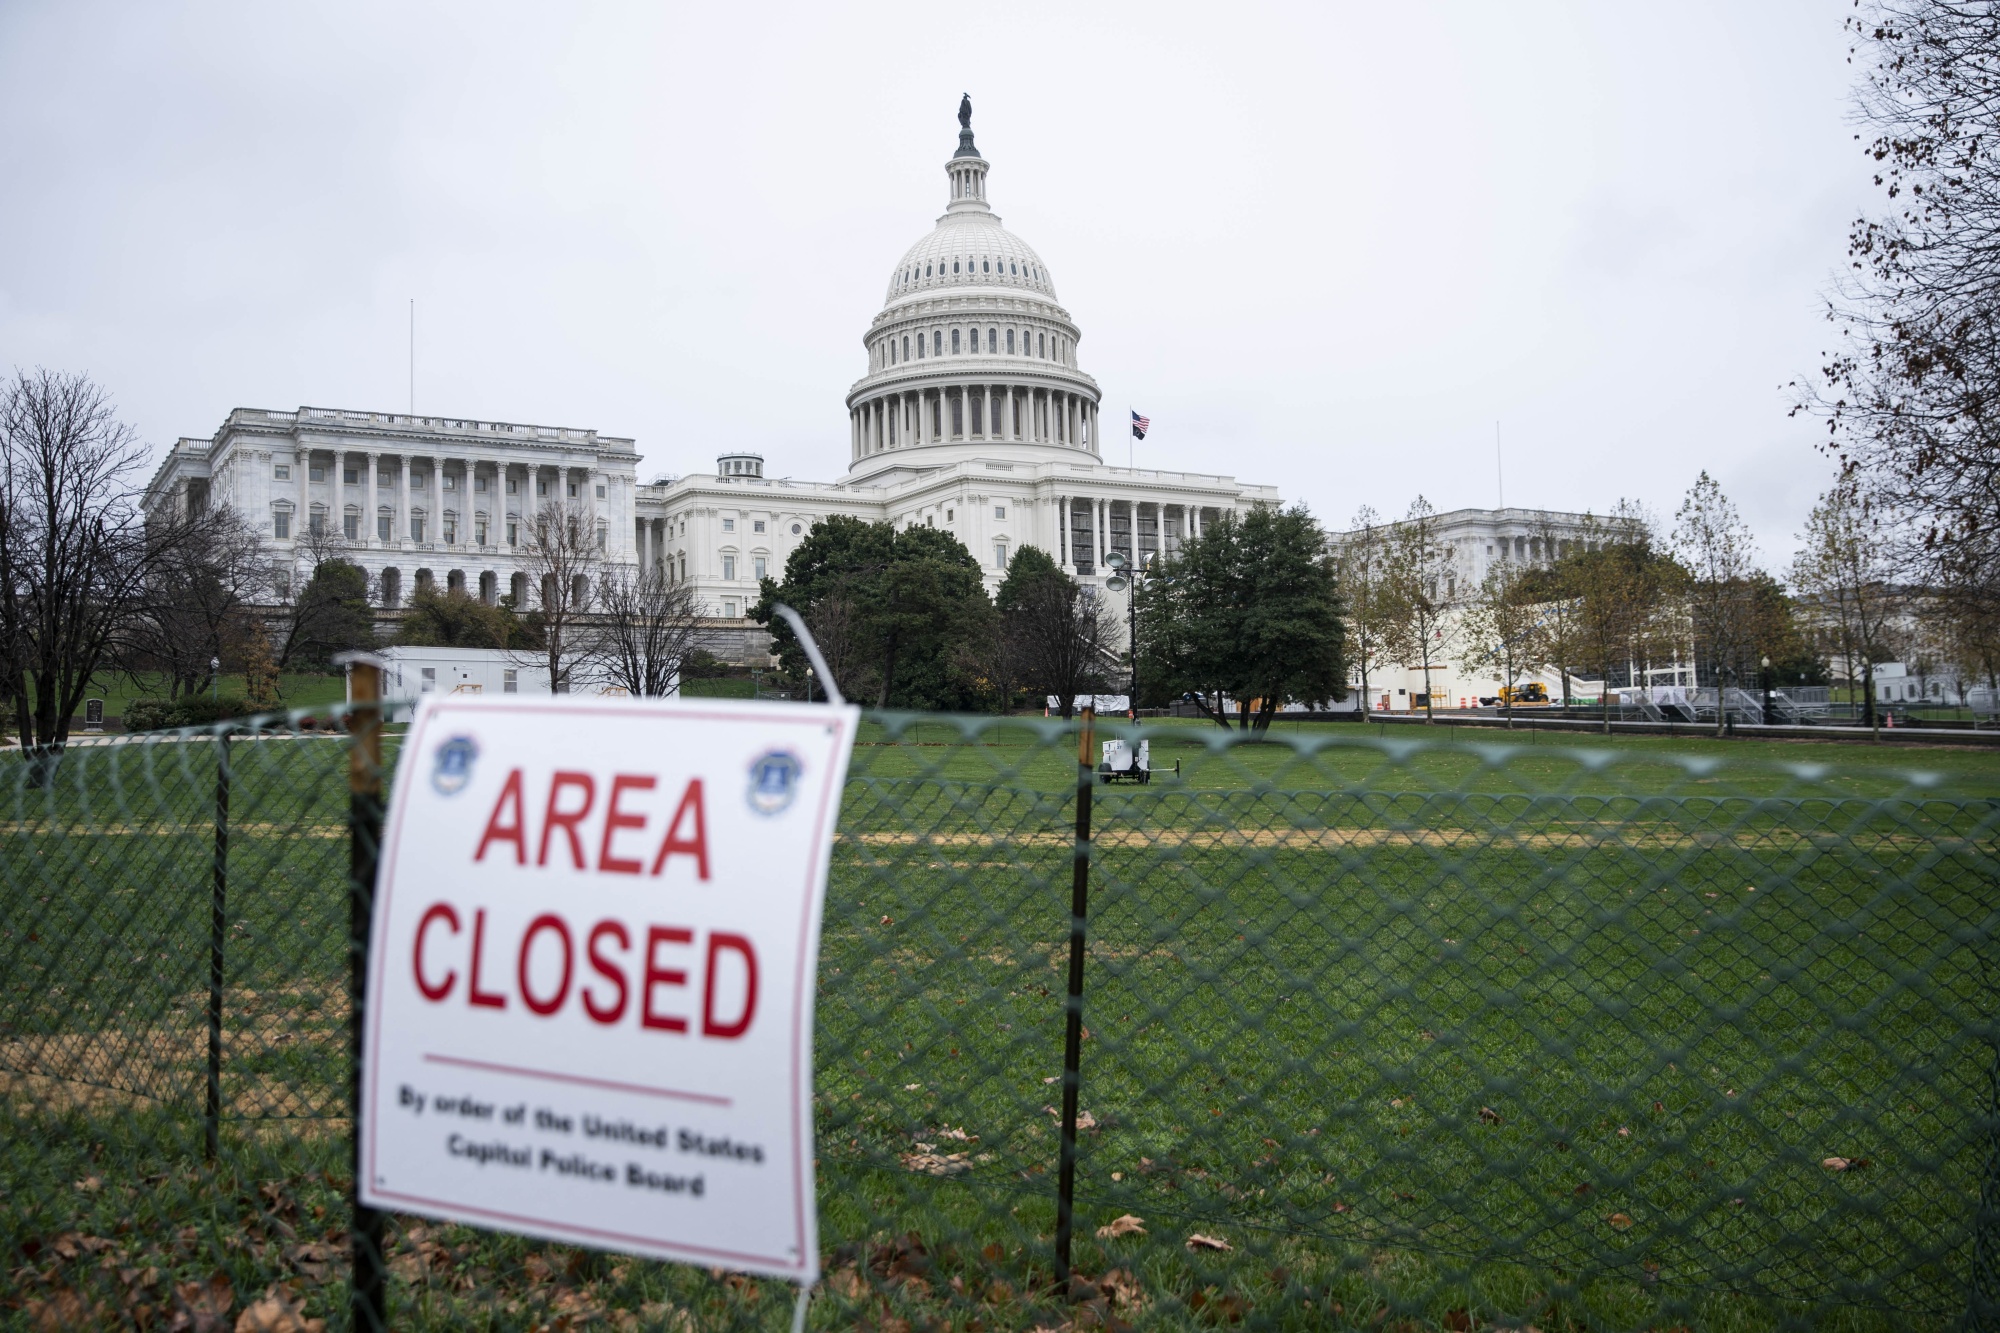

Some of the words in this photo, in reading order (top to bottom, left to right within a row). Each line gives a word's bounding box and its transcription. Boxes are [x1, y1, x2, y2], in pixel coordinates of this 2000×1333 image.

[474, 769, 711, 882] AREA
[413, 902, 760, 1041] CLOSED
[398, 1084, 426, 1115] By
[433, 1096, 494, 1120] order
[502, 1104, 526, 1125] of
[534, 1108, 574, 1134] the
[582, 1115, 668, 1150] United
[676, 1128, 765, 1165] States
[447, 1133, 532, 1168] Capitol
[539, 1148, 617, 1182] Police
[625, 1162, 705, 1198] Board
